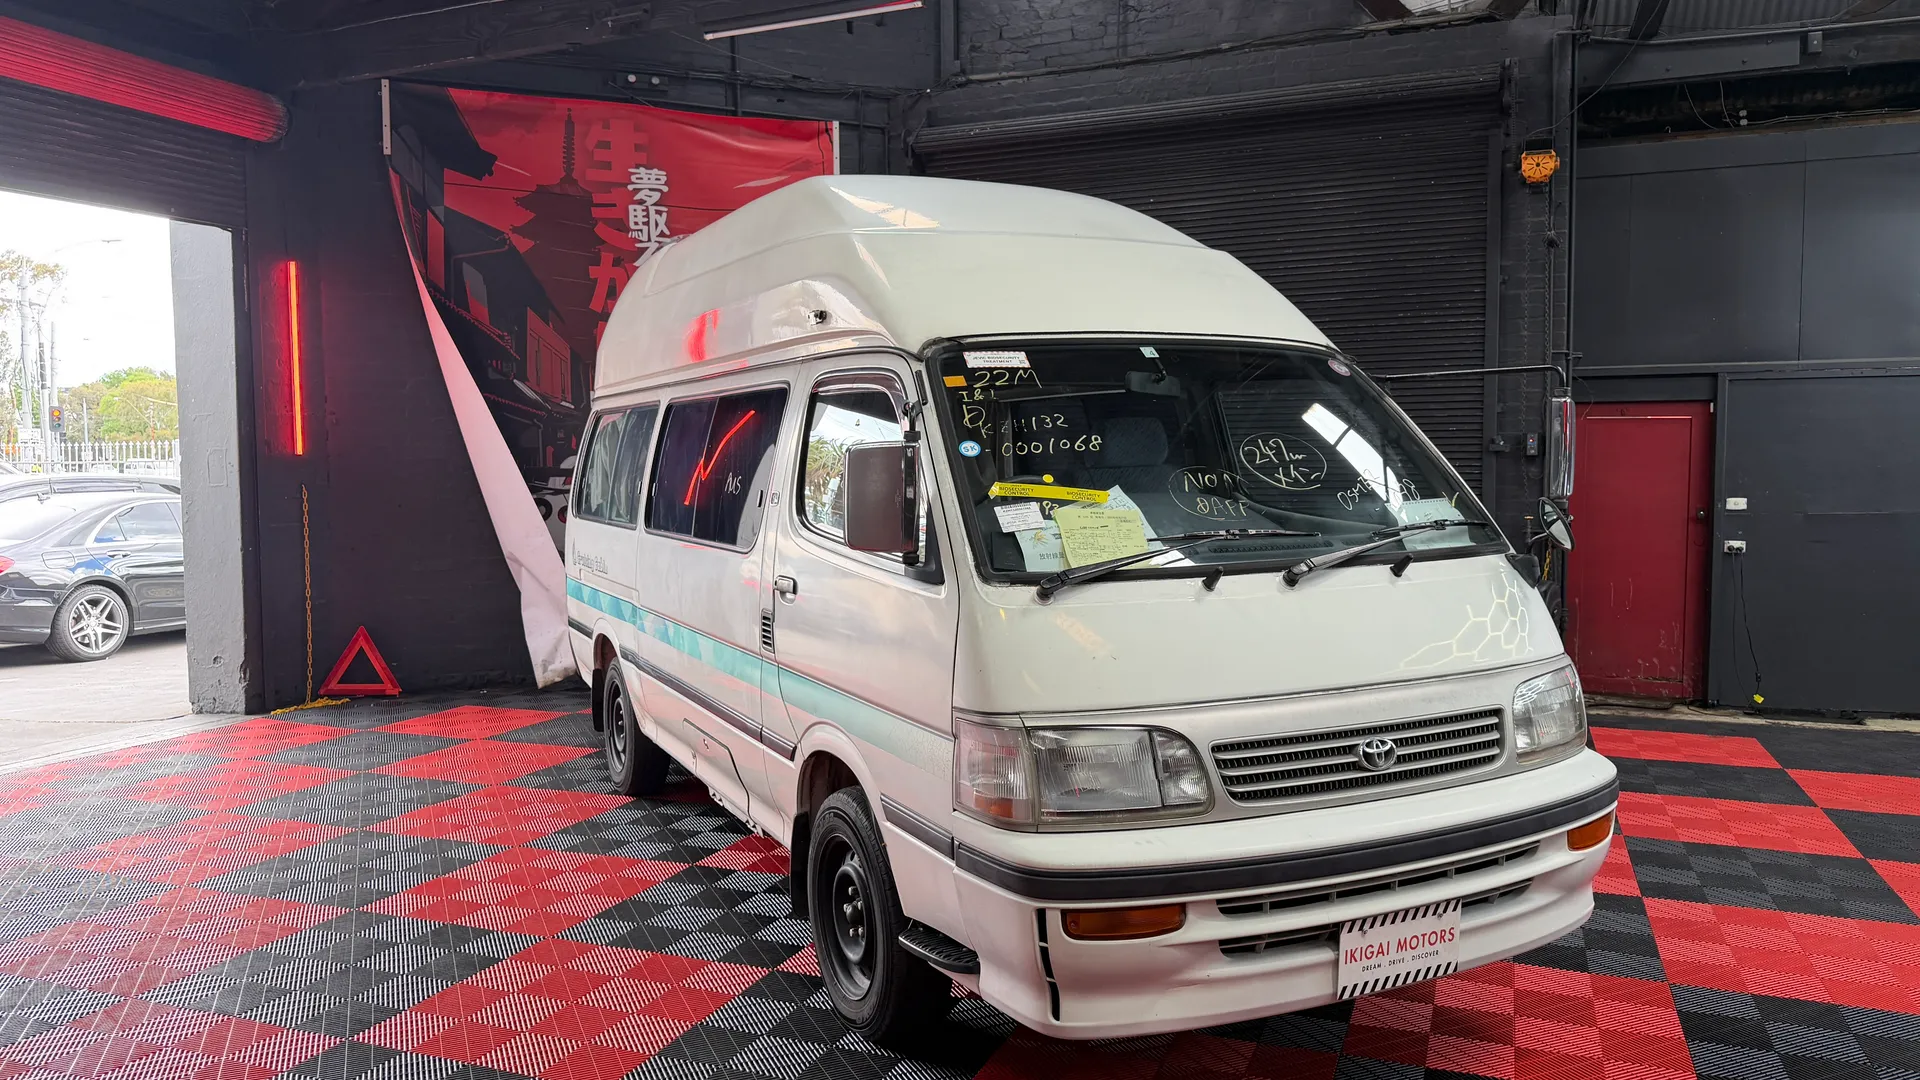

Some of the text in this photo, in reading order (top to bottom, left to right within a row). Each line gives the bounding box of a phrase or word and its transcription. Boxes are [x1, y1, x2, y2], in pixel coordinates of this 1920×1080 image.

[1344, 927, 1455, 965] IKIGAI MOTORS
[1361, 949, 1439, 973] DREAM DRIVE DISCOVER
